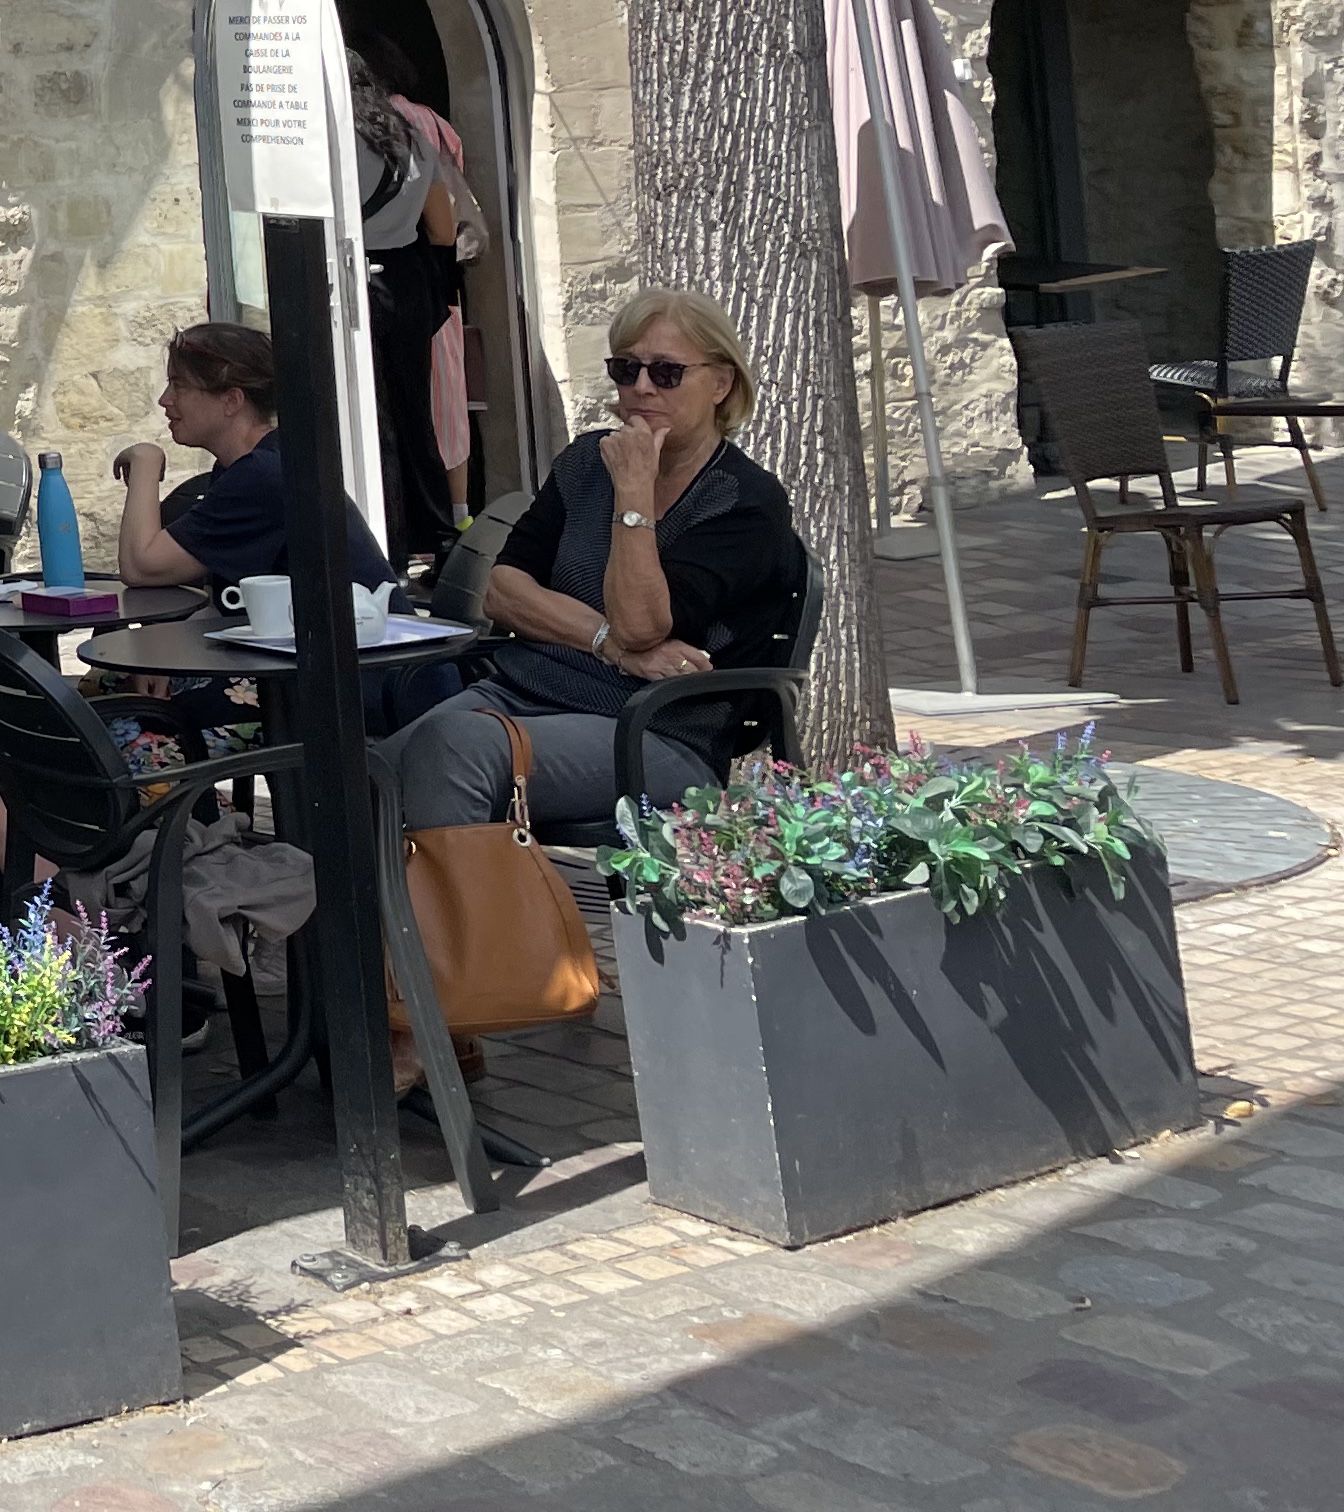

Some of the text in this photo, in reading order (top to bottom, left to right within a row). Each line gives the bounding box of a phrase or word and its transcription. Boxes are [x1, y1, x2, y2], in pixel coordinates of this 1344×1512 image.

[228, 15, 307, 26] MERCI DE PASSER VOS
[234, 32, 300, 42] COMMANDES A LA
[244, 48, 290, 58] CAISSE DE LA
[242, 64, 293, 75] BOULANGERIE
[240, 83, 297, 93] PAS DE PRISE DE
[285, 100, 308, 110] TABLE
[236, 118, 307, 129] MERCI POUR VOTRE
